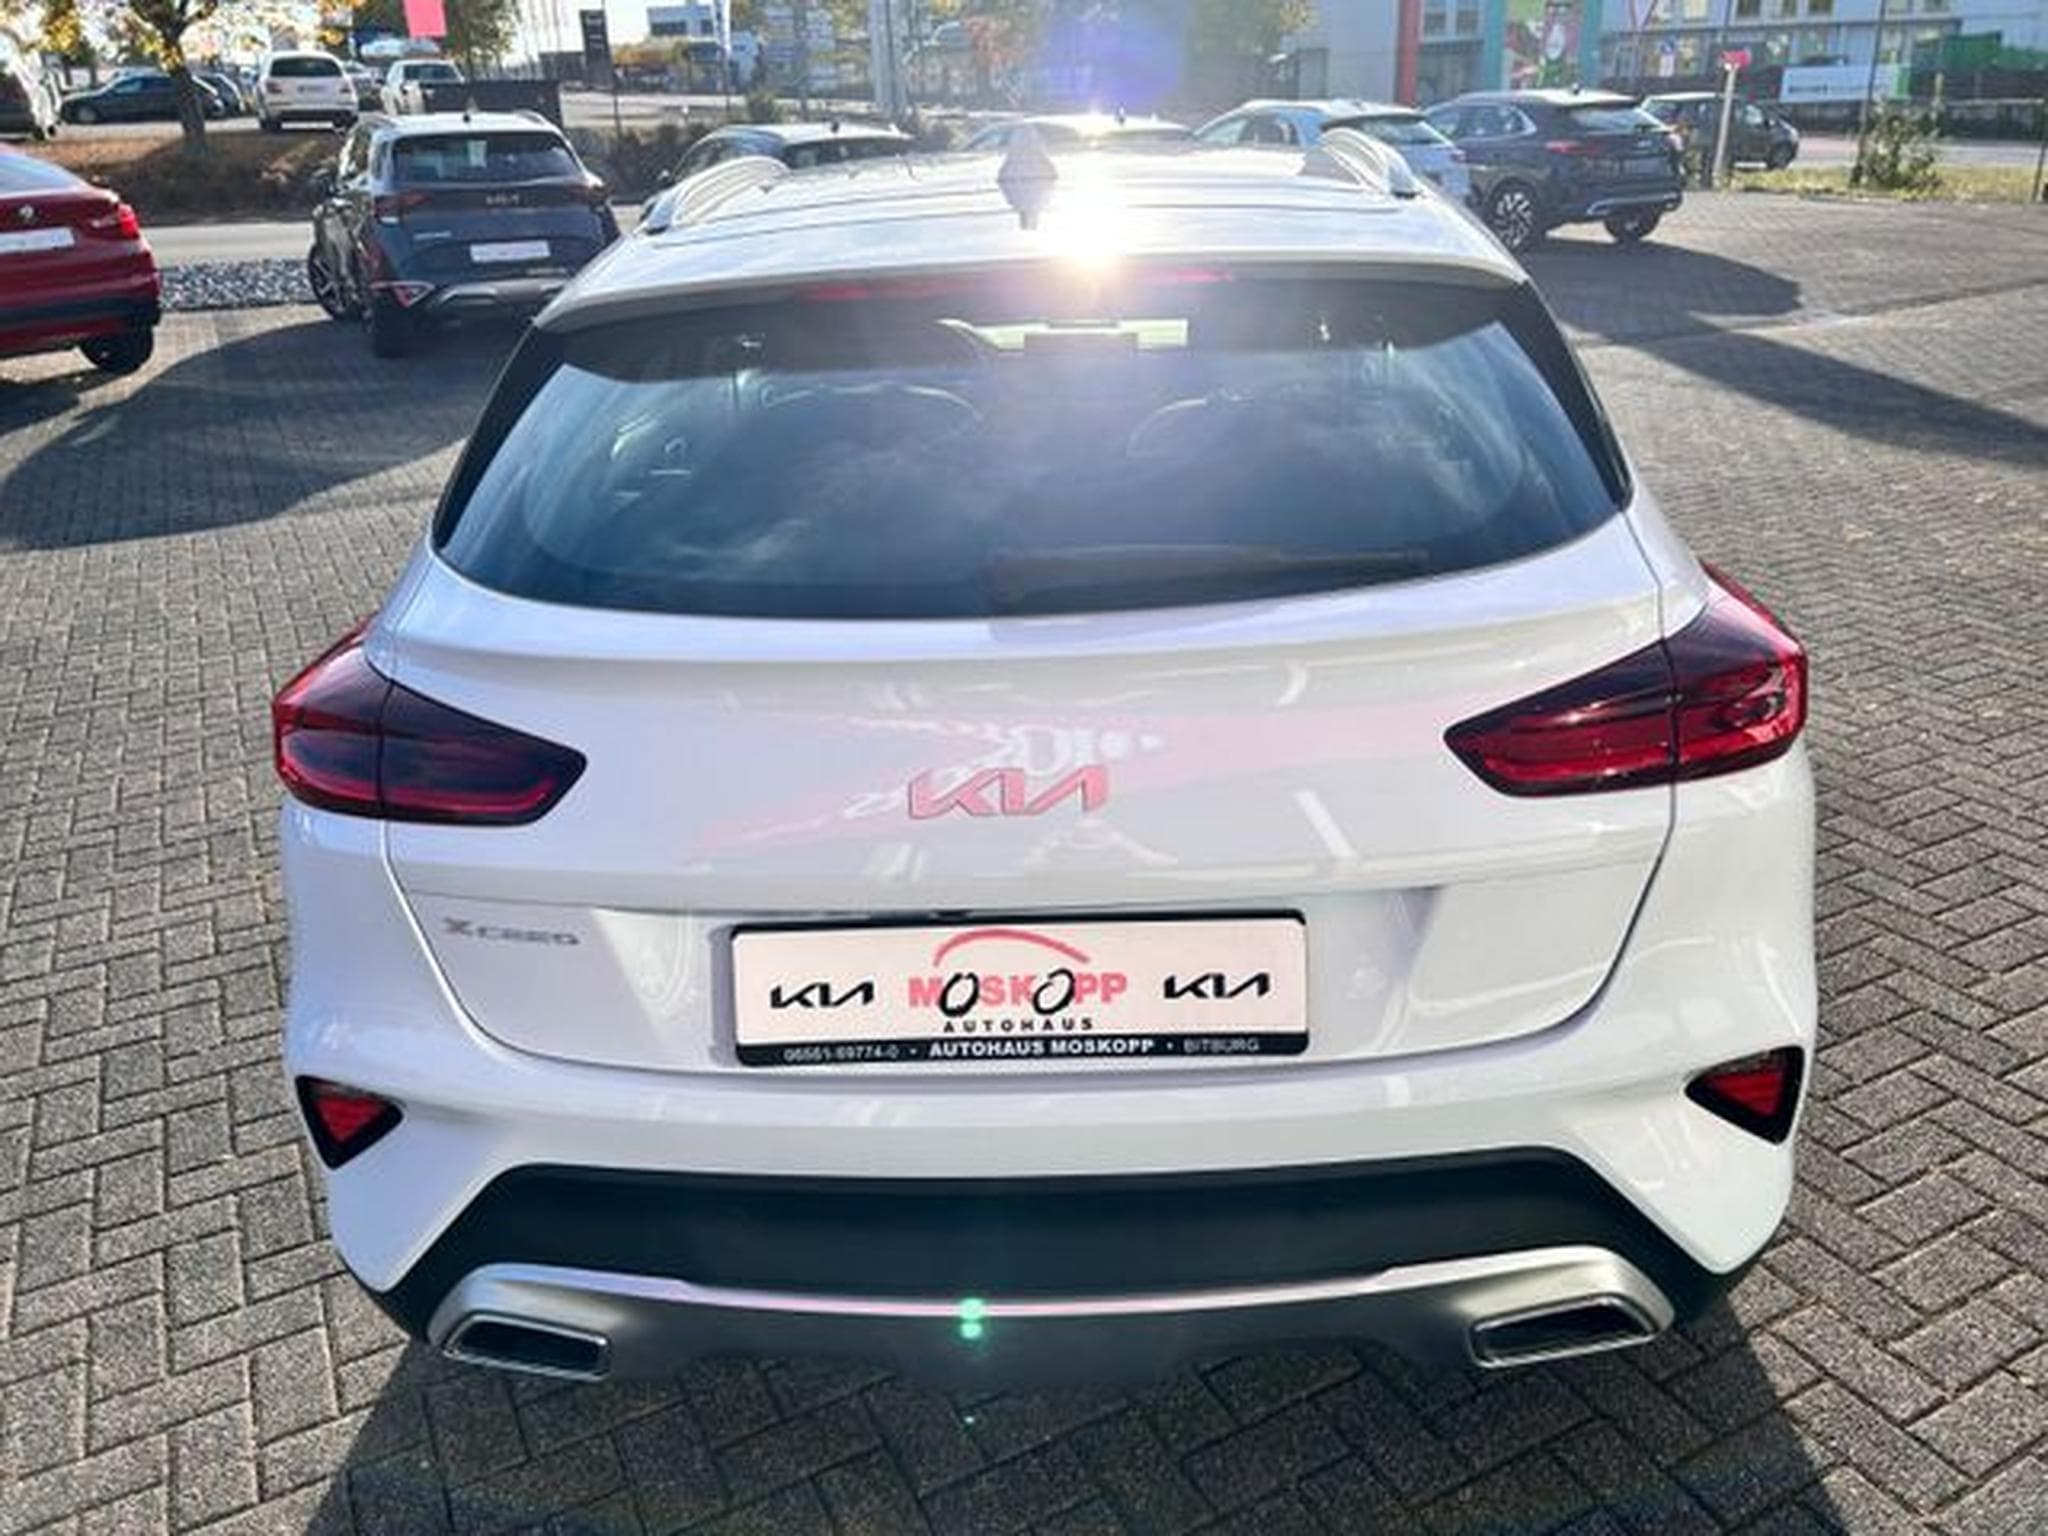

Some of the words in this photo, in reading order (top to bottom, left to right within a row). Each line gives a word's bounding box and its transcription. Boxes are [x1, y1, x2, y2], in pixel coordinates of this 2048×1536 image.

[908, 764, 1110, 820] KIA
[770, 981, 874, 1009] KIA
[908, 968, 1128, 1017] MOSKOPP
[1164, 972, 1270, 999] KIA
[943, 1017, 1094, 1033] AUTOHAUS
[929, 1040, 1045, 1057] AUTOHAUS
[1051, 1037, 1155, 1055] MOSKOPP
[1183, 1037, 1260, 1053] BITBURG
